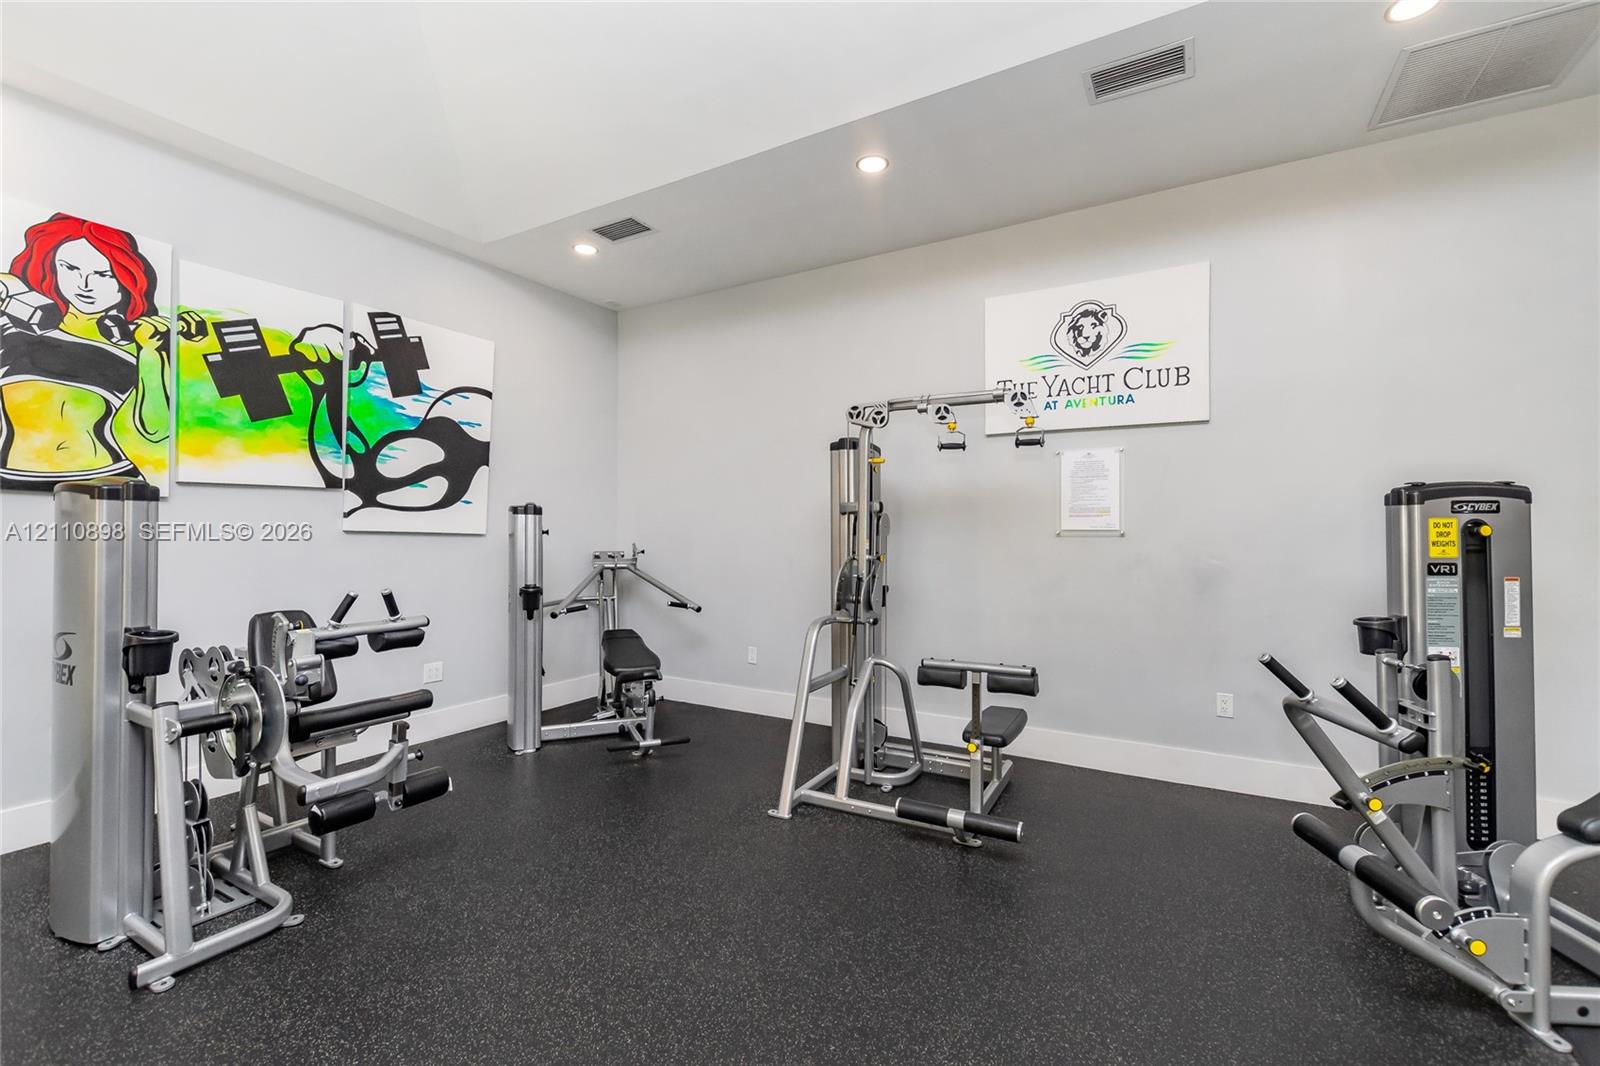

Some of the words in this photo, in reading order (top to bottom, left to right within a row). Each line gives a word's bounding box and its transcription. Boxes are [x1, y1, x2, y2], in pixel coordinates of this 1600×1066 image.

[1042, 373, 1115, 398] YACHT
[1123, 366, 1190, 391] CLUB
[1043, 400, 1059, 411] AT
[1064, 394, 1135, 409] AVENTURA
[1467, 503, 1498, 511] CYBEX
[1430, 565, 1456, 574] VR1
